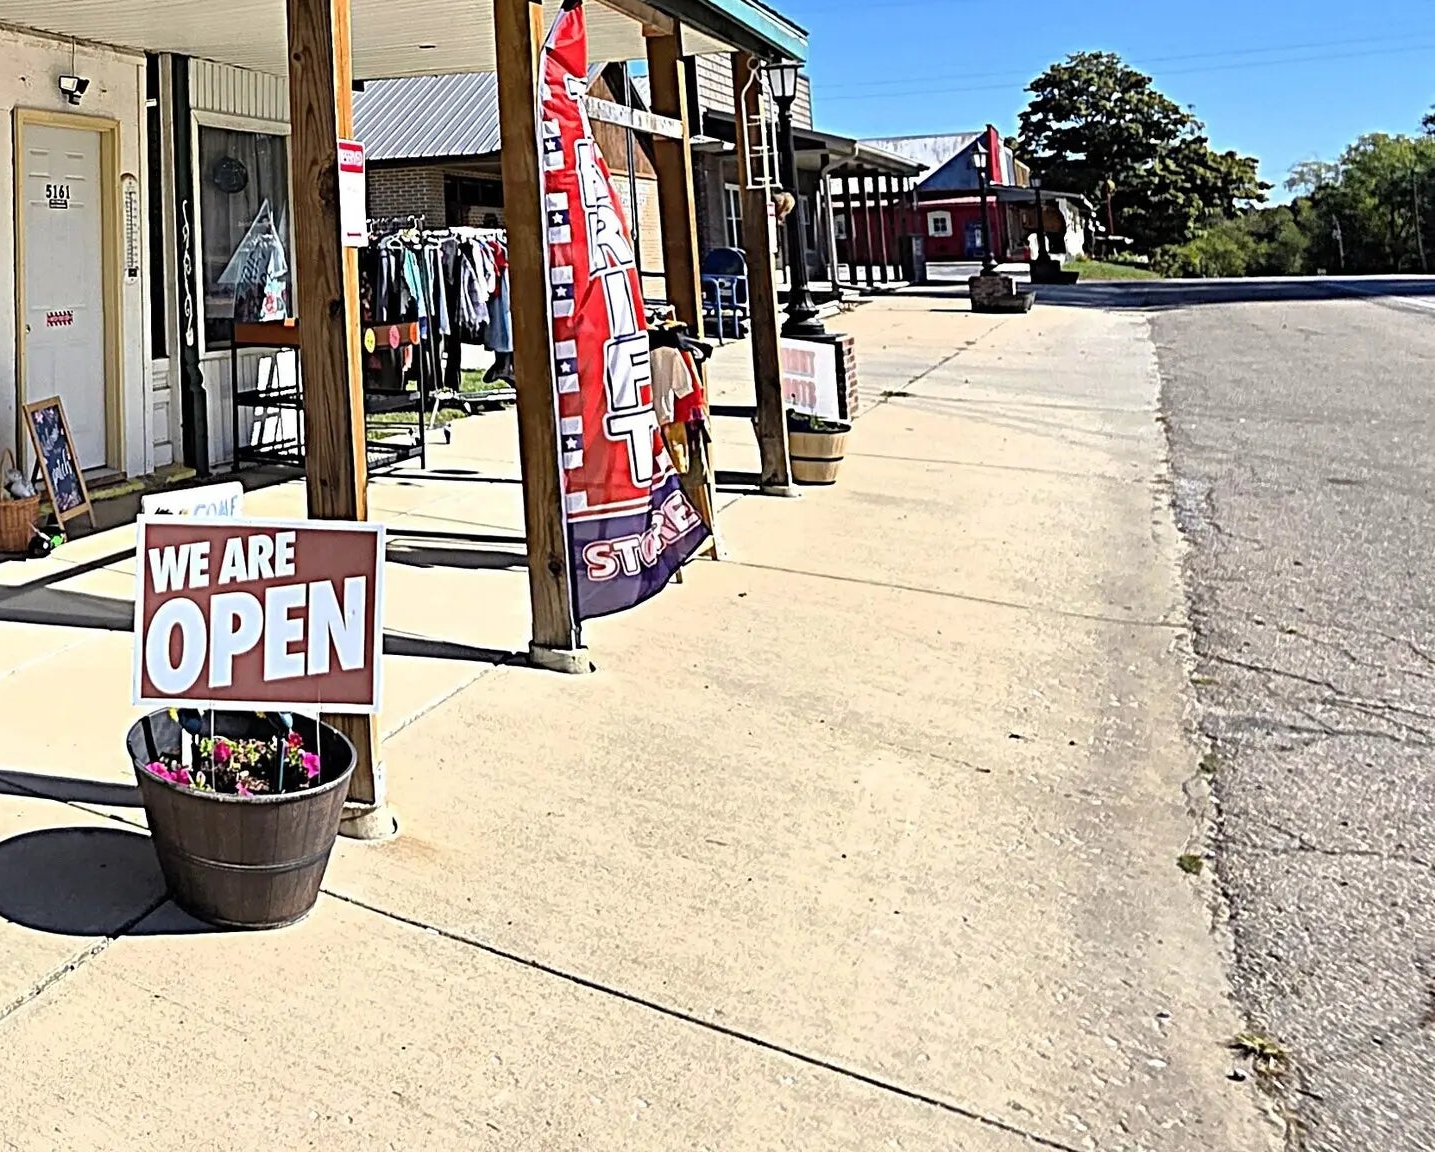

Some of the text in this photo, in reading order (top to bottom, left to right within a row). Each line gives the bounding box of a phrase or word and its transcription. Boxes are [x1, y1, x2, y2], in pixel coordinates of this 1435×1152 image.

[45, 183, 71, 200] 5161
[148, 530, 297, 594] WE ARE
[582, 488, 703, 583] STORE
[145, 575, 367, 695] OPEN
